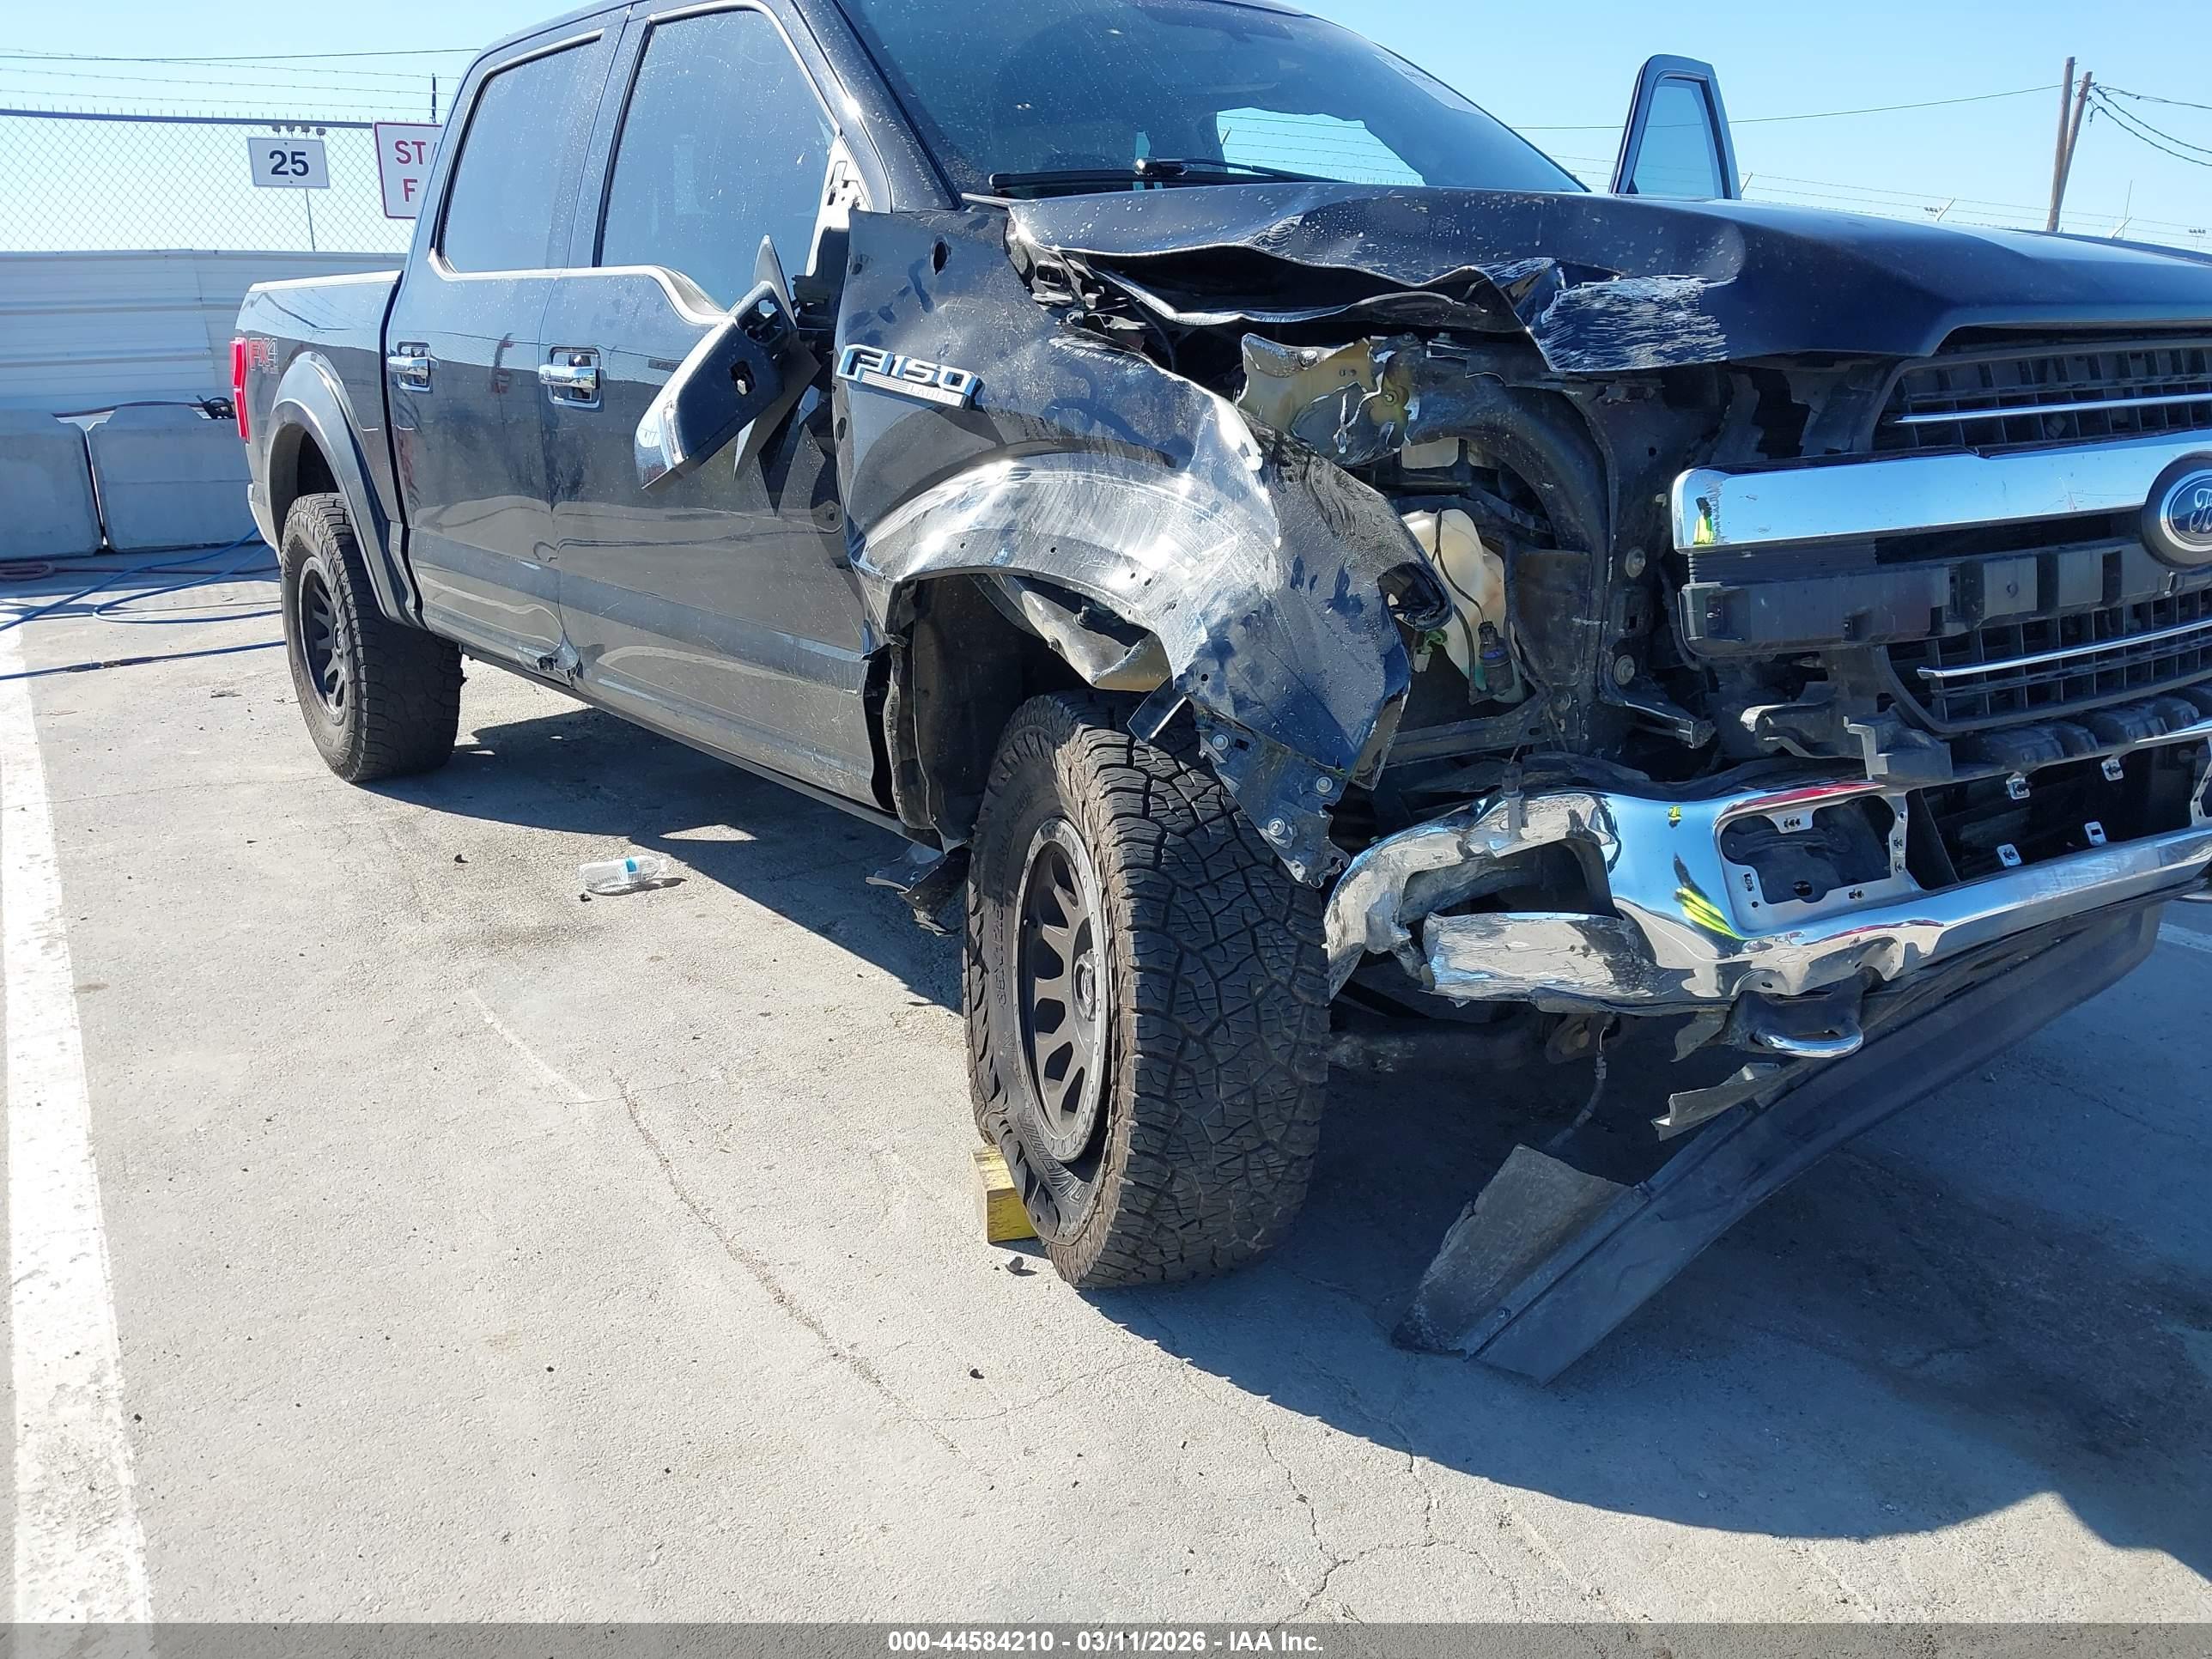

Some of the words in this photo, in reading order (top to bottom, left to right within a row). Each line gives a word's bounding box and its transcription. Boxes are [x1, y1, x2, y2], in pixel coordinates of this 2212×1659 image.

[269, 149, 309, 177] 25
[394, 140, 437, 165] ST
[249, 337, 279, 371] FX4
